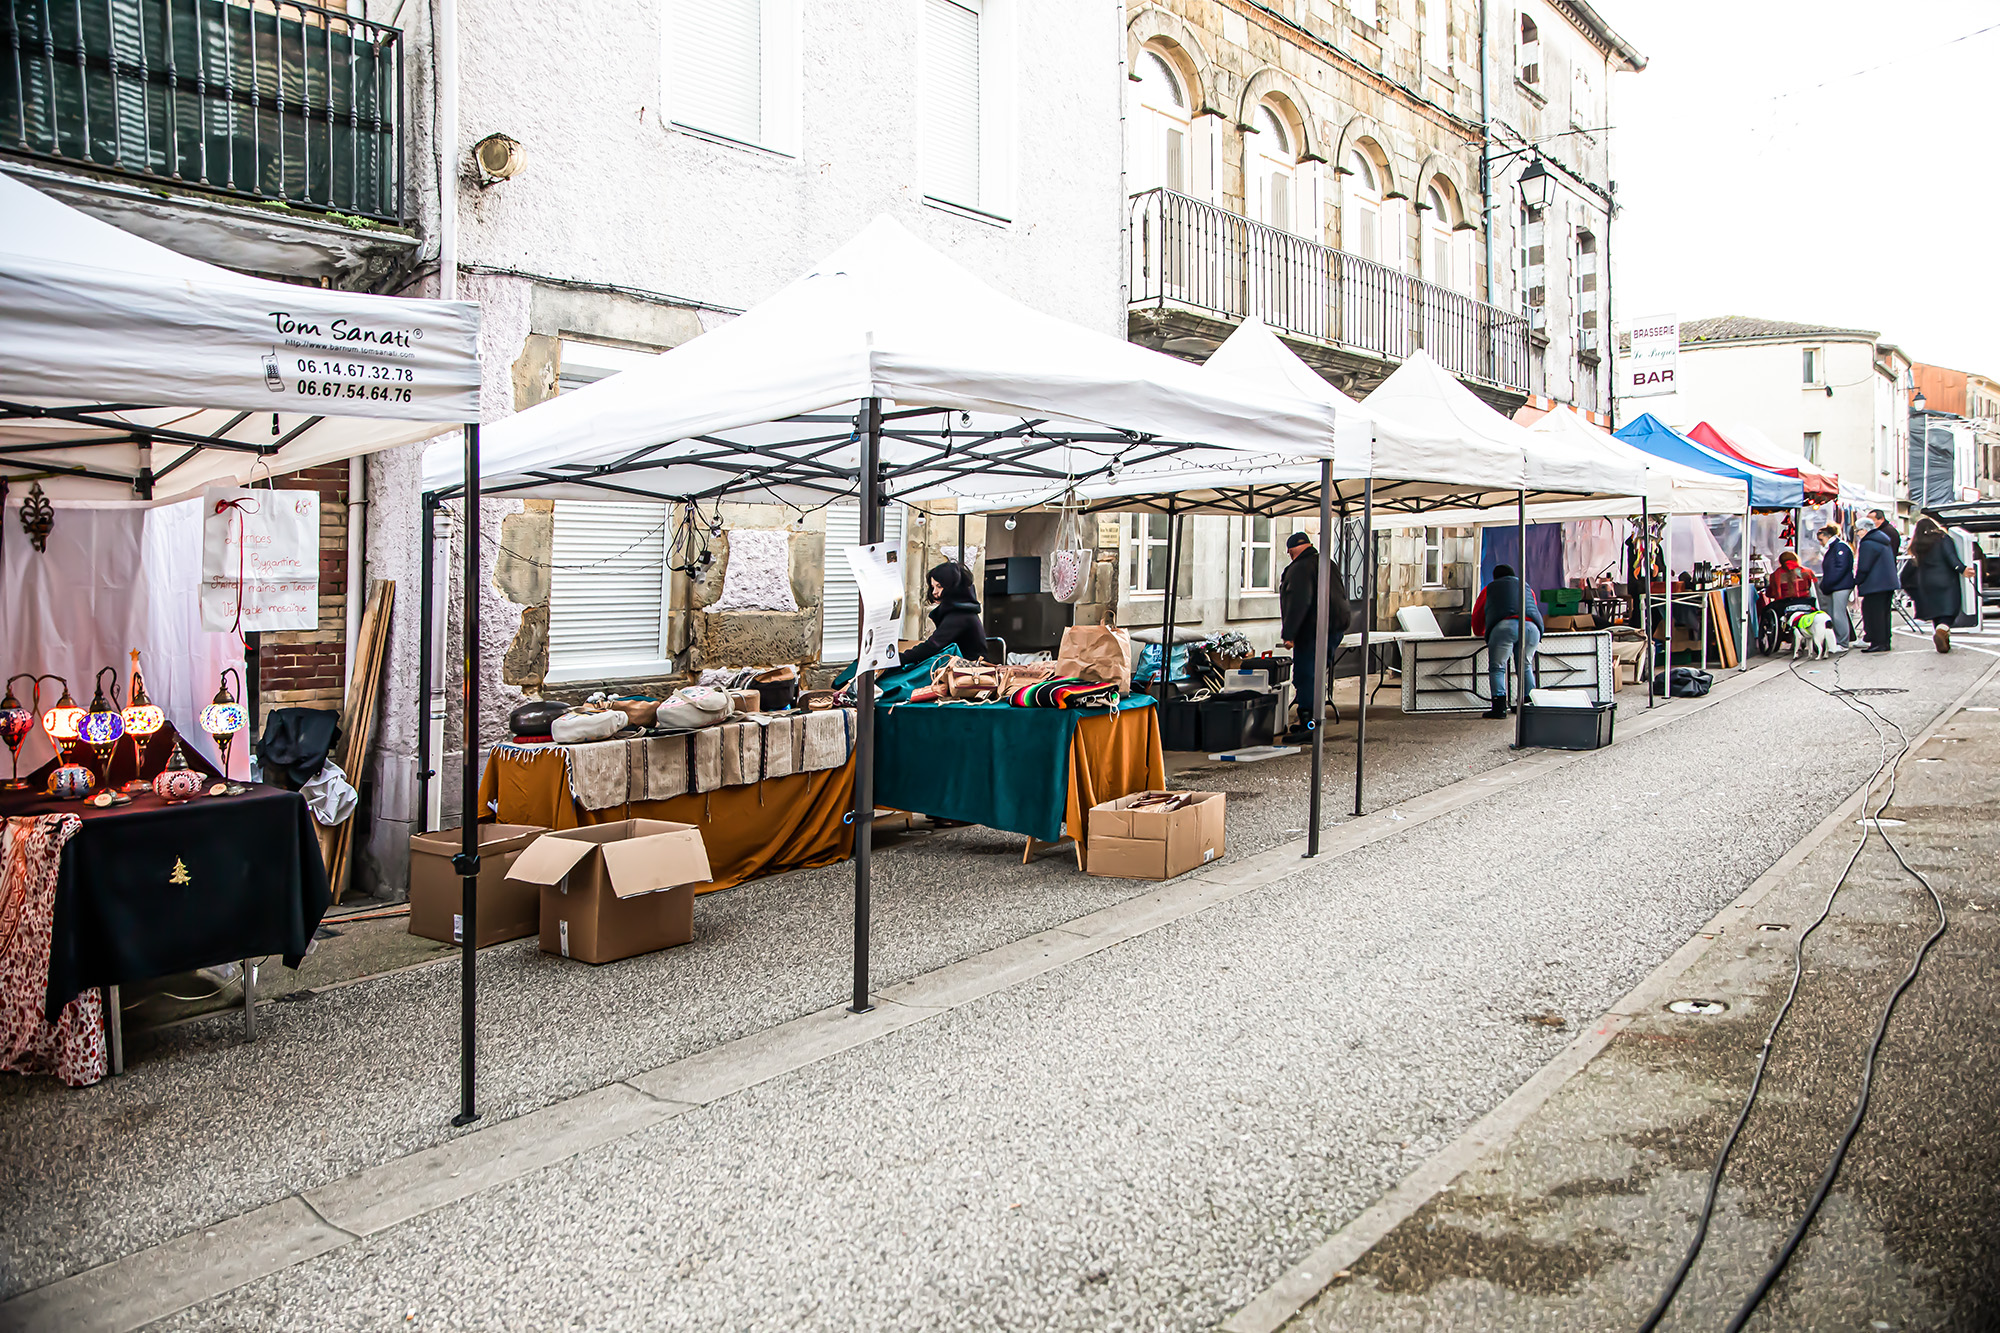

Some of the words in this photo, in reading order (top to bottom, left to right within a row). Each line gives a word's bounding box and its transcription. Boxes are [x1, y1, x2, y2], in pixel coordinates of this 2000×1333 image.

[268, 311, 322, 337] Tom
[1633, 325, 1675, 339] BRASSERIE
[297, 358, 414, 382] 06.14.67.32.78
[1633, 369, 1674, 386] BAR
[297, 379, 413, 403] 06.67.54.64.76
[222, 601, 263, 617] Vértable
